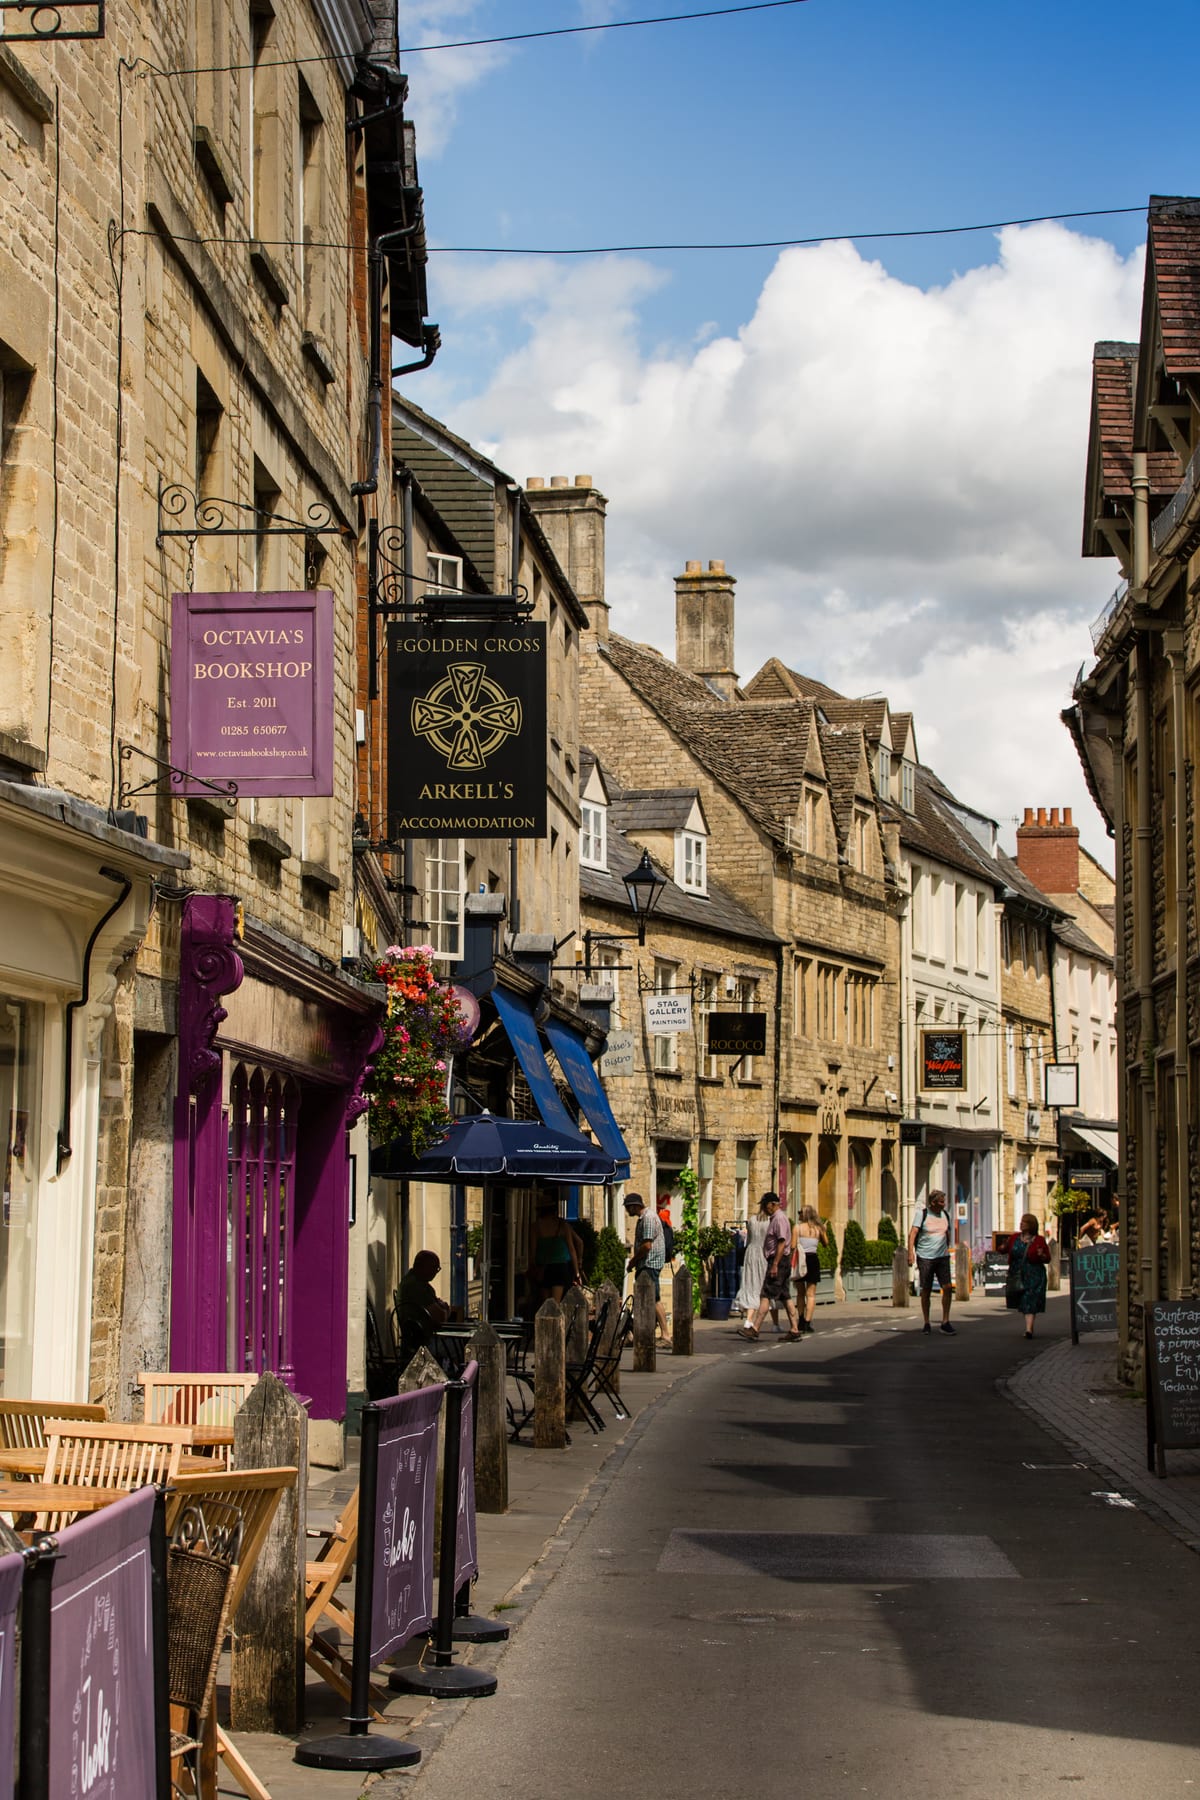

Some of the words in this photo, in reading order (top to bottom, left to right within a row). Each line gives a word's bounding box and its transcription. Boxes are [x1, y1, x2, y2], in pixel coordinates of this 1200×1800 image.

[203, 629, 304, 645] OCTAVIA'S
[404, 638, 478, 653] GOLDEN
[484, 638, 540, 653] CROSS
[193, 662, 312, 680] BOOKSHOP
[253, 697, 277, 709] 2011
[221, 726, 248, 736] 01285
[253, 725, 287, 735] 650677
[418, 781, 514, 800] ARKELL'S
[399, 817, 535, 829] ACCOMMODATION
[657, 1000, 679, 1008] STAG
[649, 1007, 688, 1016] GALLERY
[608, 1040, 632, 1052] esse's
[711, 1039, 763, 1050] ROCOCO
[604, 1055, 632, 1068] Bistro
[925, 1059, 961, 1073] Waffles
[1154, 1324, 1200, 1336] cotswo
[1158, 1352, 1171, 1364] to
[1172, 1351, 1193, 1364] the
[1175, 1363, 1200, 1382] Enj
